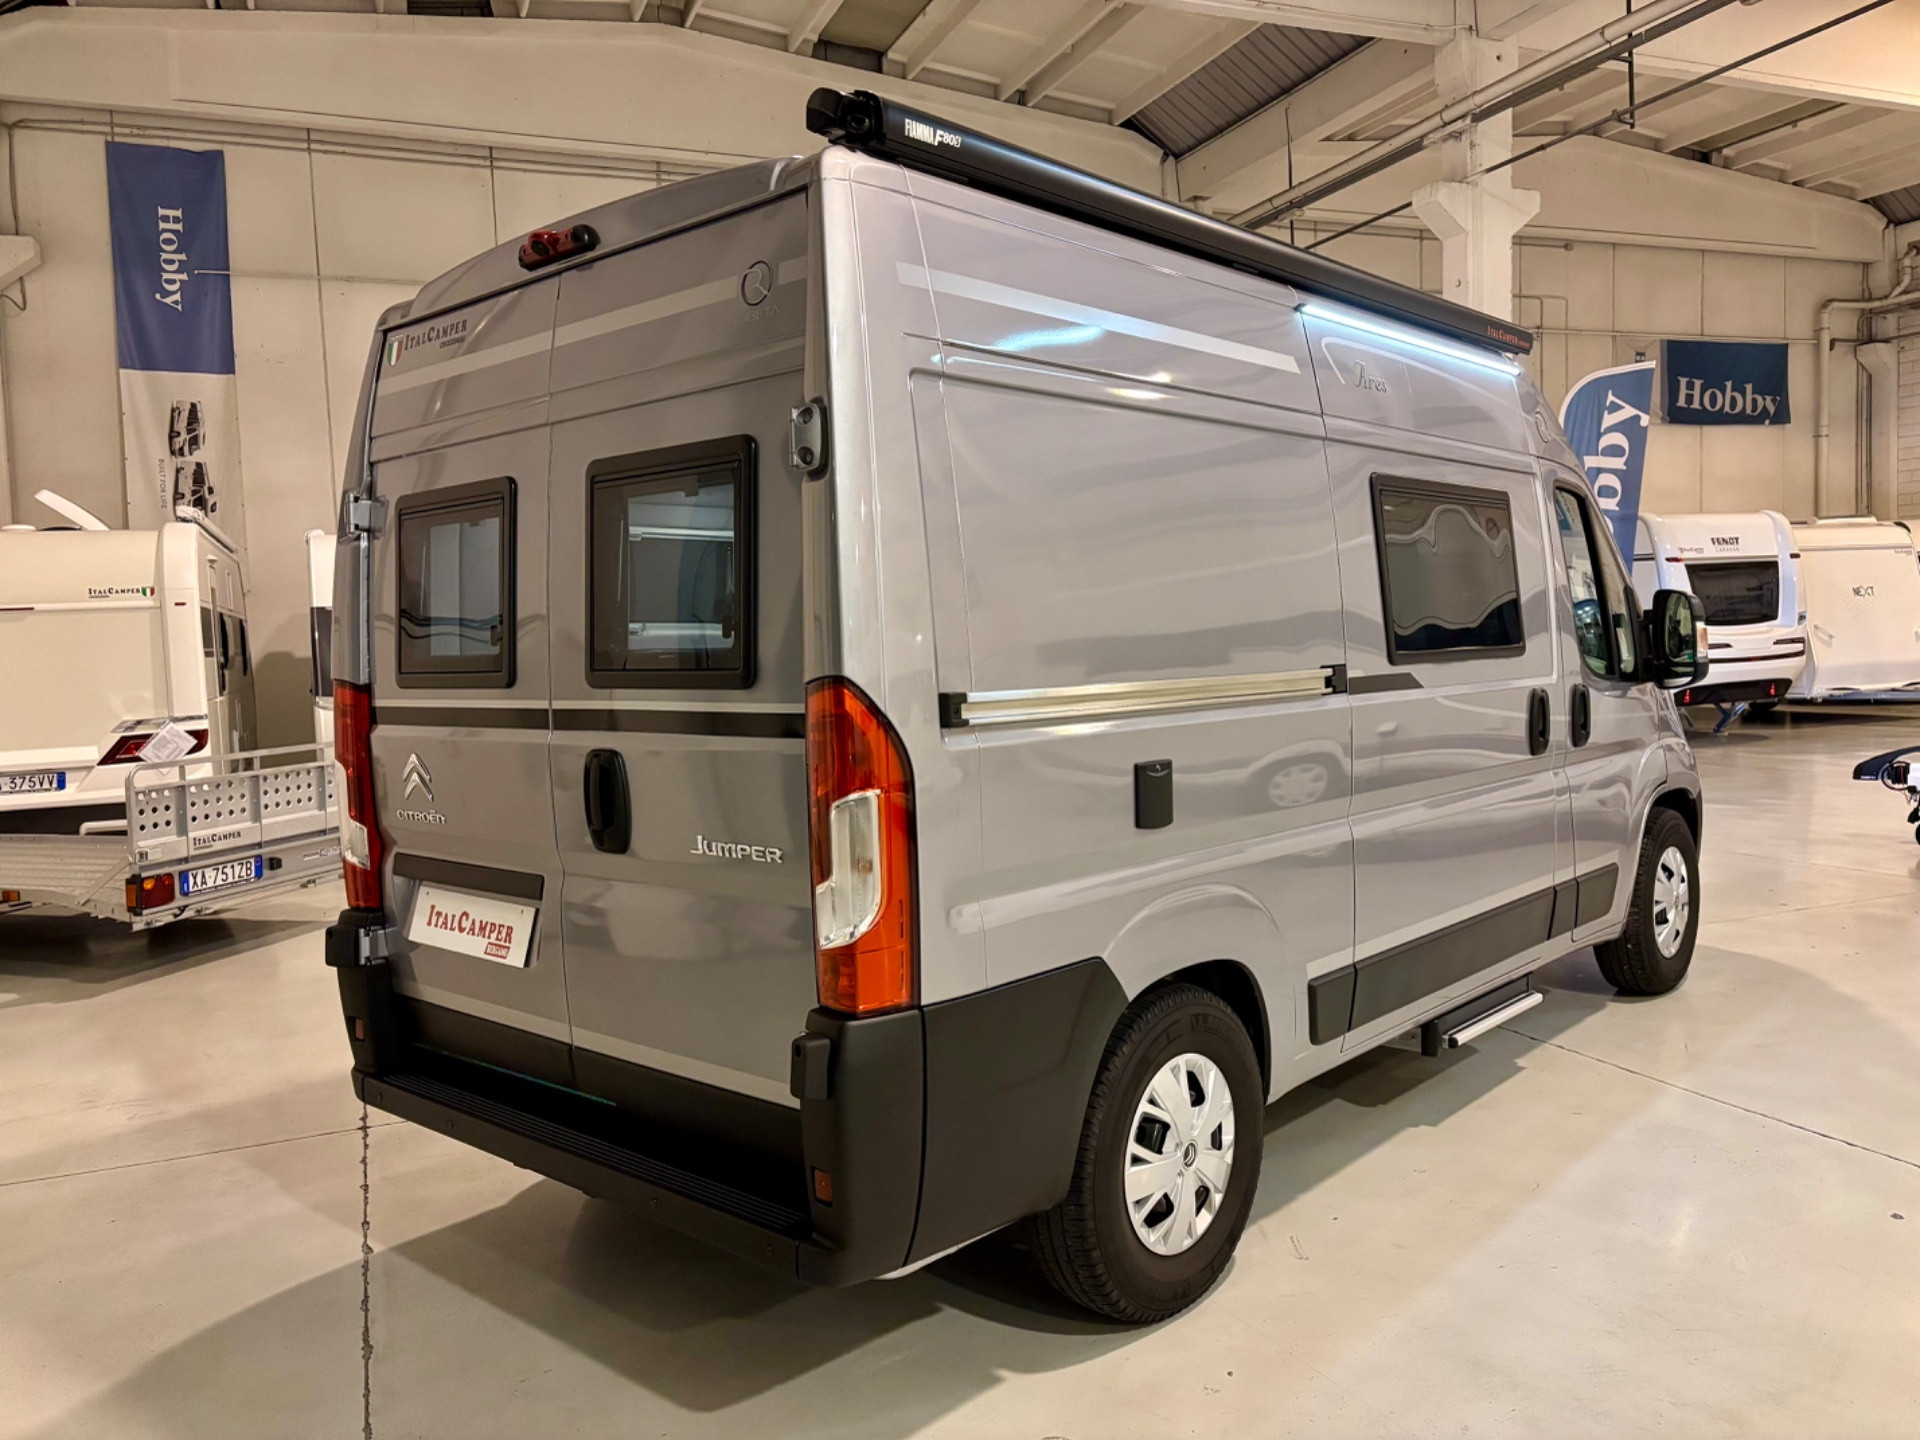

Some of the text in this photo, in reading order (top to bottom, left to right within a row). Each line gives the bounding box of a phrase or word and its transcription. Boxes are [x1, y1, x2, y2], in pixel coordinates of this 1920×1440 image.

[155, 205, 188, 312] Hobby
[1675, 375, 1781, 426] Hobby
[1583, 389, 1650, 535] bby
[1711, 536, 1740, 546] FENDT
[396, 808, 447, 825] CITROËN
